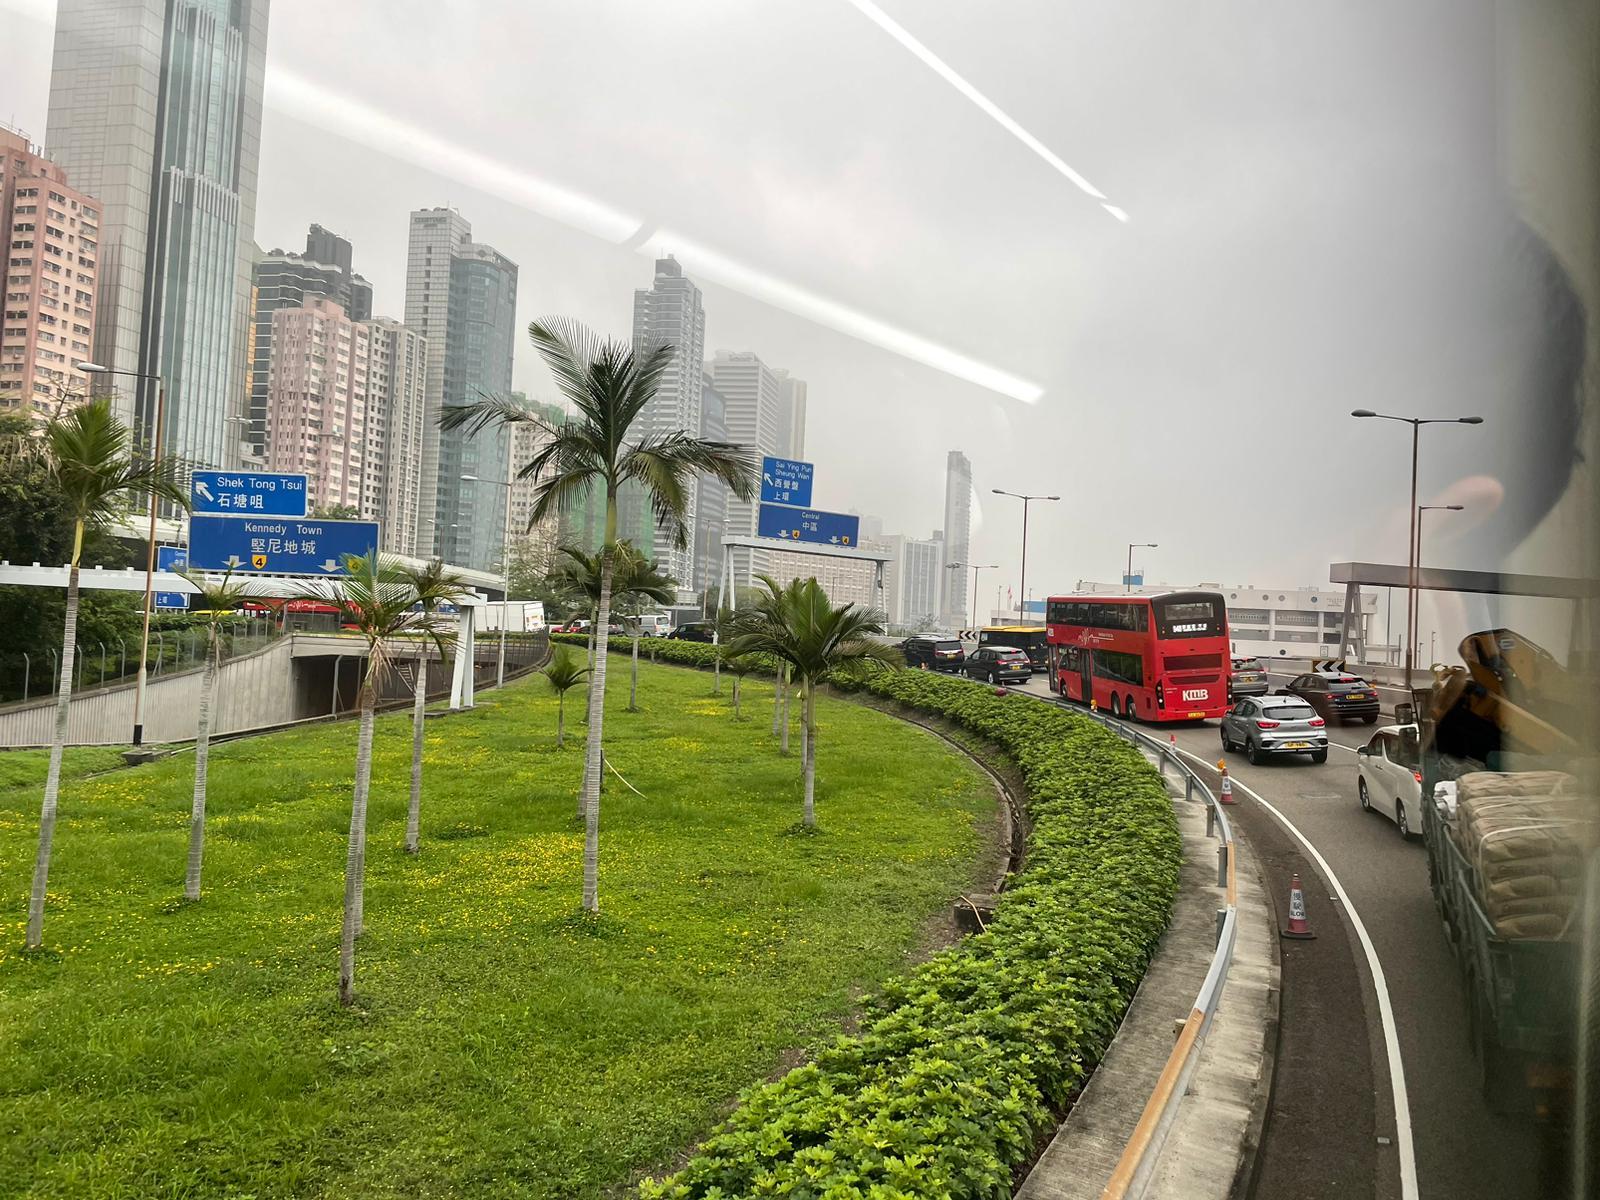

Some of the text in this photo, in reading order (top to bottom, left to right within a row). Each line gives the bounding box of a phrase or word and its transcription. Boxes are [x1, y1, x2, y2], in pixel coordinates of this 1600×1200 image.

[775, 469, 810, 480] Sheung Wan
[787, 463, 800, 472] Ying
[801, 465, 812, 473] Pun
[217, 476, 303, 492] Shek Tong Tsui
[217, 492, 264, 510] 石塘咀
[801, 512, 820, 520] Central
[245, 522, 323, 536] Kennedy Town
[251, 538, 317, 555] 堅尼地城
[255, 557, 264, 567] 4
[1182, 689, 1209, 702] KMB
